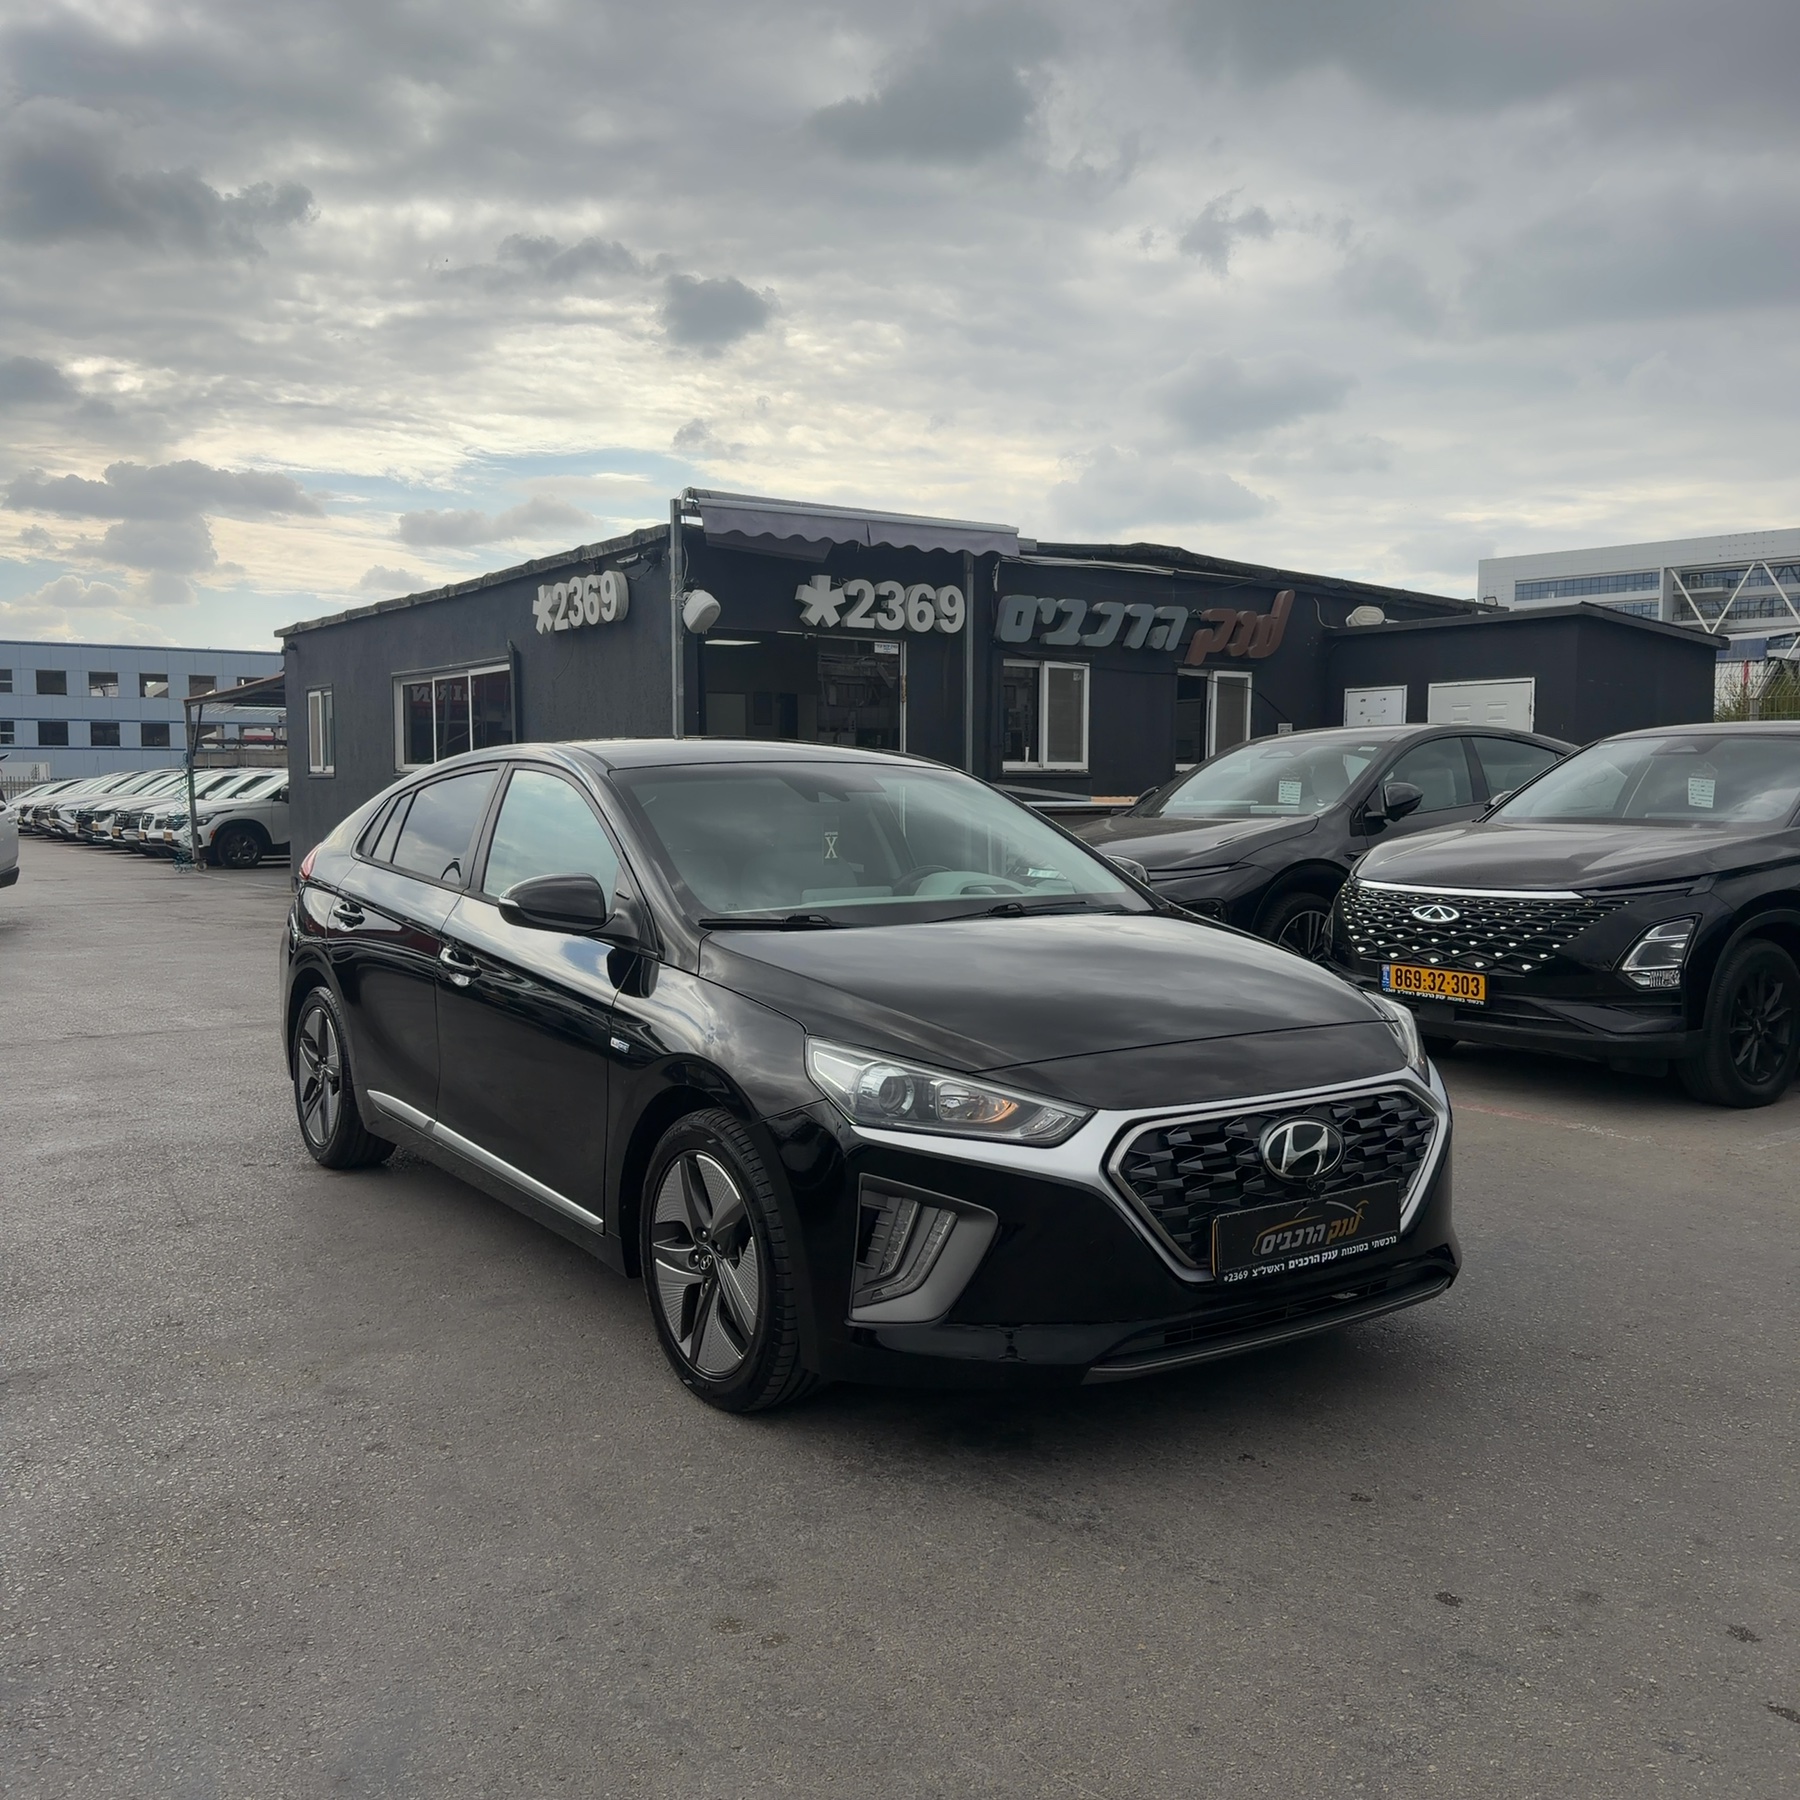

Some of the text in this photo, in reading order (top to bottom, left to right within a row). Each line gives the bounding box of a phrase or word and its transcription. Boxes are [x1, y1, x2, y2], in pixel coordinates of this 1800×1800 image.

[996, 589, 1296, 666] ענק הרכבים
[1260, 1199, 1369, 1255] ענק הרכבים
[1371, 1235, 1397, 1249] נרכשתי
[1321, 1249, 1339, 1263] ענק
[1341, 1243, 1369, 1257] בסוכנות
[1288, 1254, 1320, 1270] הרכבים
